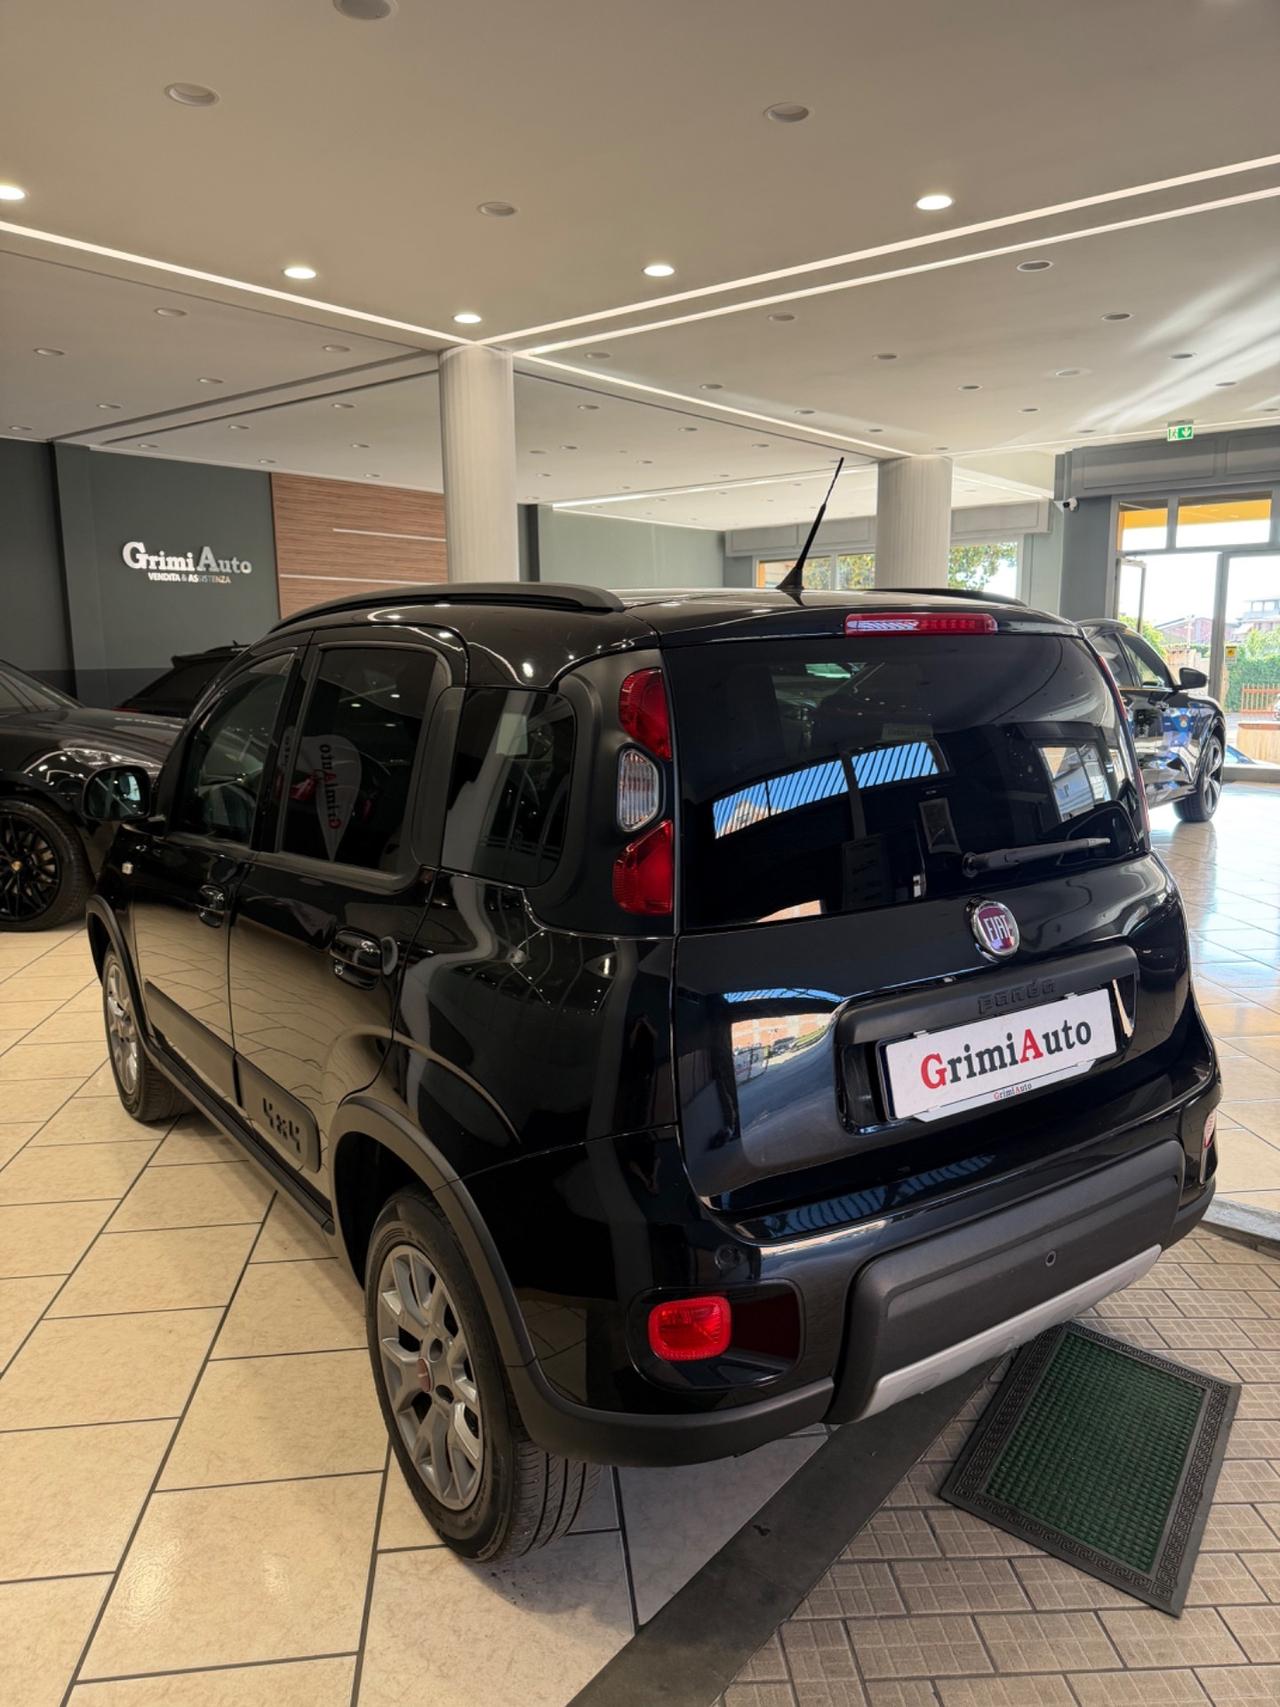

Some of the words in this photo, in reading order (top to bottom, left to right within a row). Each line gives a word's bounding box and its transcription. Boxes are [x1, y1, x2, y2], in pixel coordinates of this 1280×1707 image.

[148, 572, 181, 582] VENDITA
[983, 914, 1011, 941] FIAT
[920, 1019, 1092, 1090] GrimiAuto
[993, 1082, 1033, 1100] GrimiAuto
